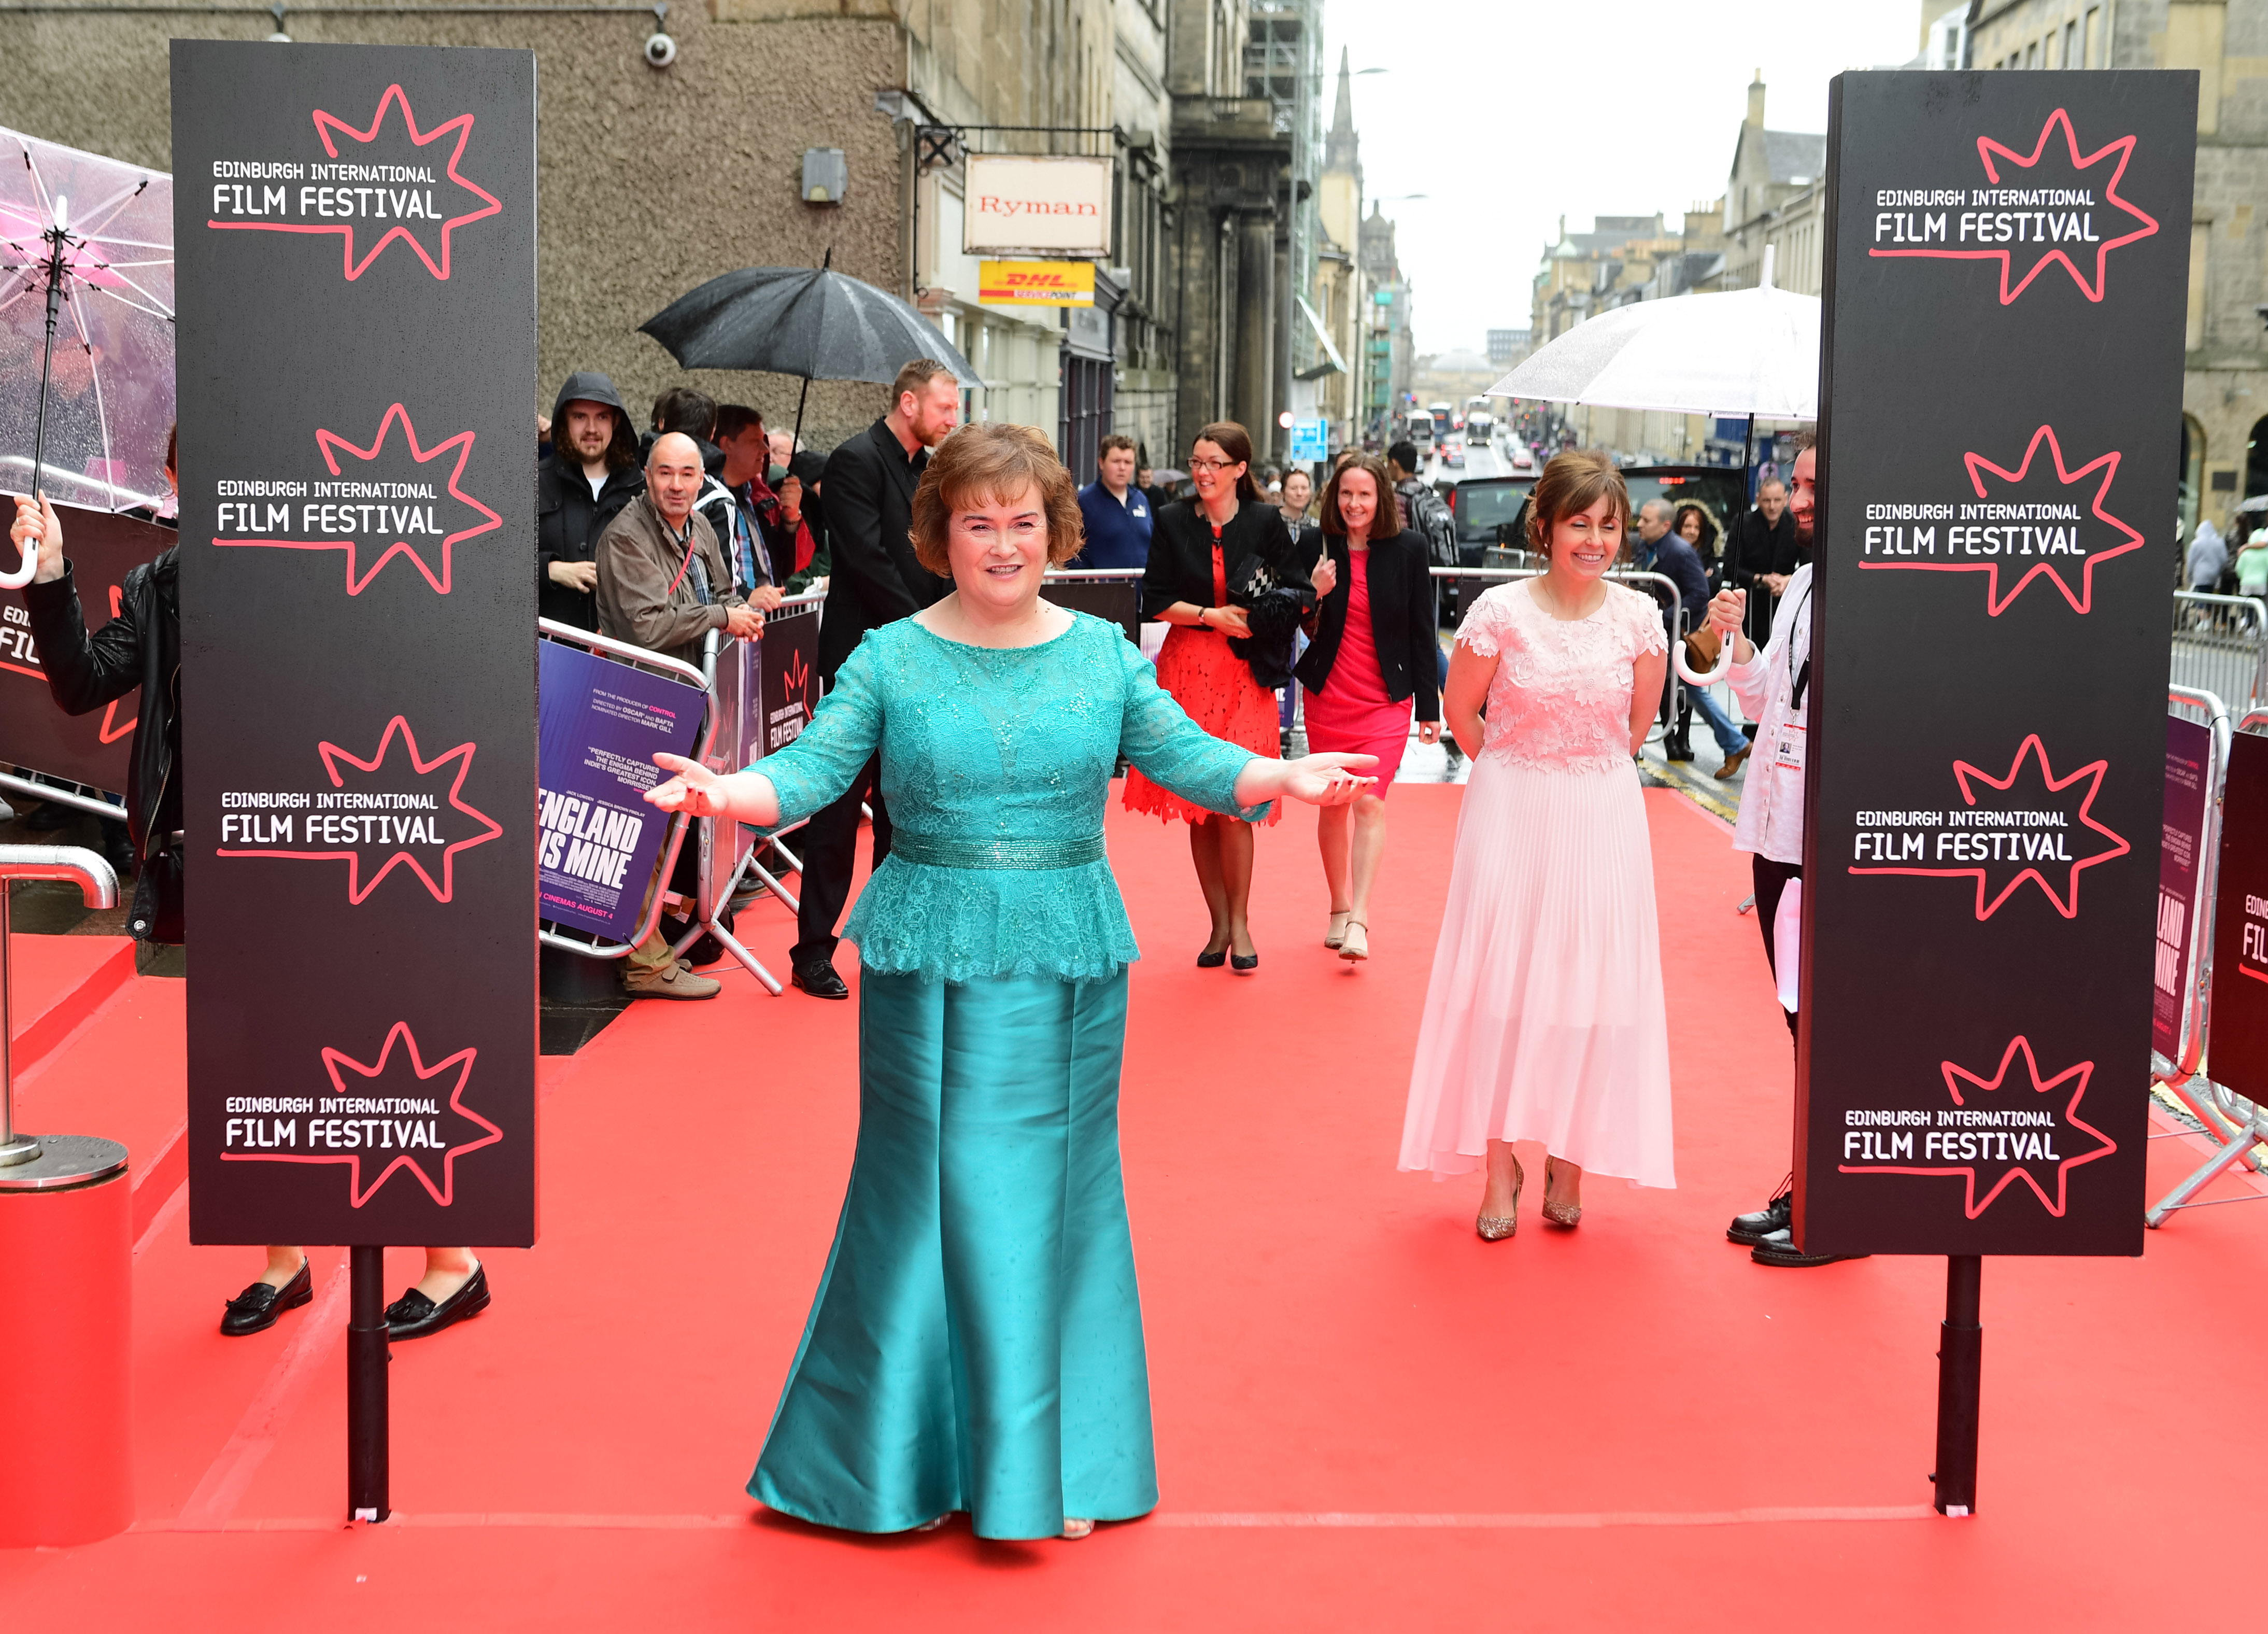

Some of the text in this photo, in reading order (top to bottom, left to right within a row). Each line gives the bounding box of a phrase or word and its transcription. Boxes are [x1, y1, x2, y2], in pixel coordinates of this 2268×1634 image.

[213, 161, 436, 183] EDINBURGH INTERNATIONAL
[214, 184, 443, 219] FILM FESTIVAL
[979, 196, 1097, 217] Ryman
[1877, 189, 2095, 206] EDINBURGH INTERNATIONAL
[1875, 212, 2100, 242] FILM FESTIVAL
[1007, 273, 1065, 286] DHL
[218, 480, 437, 499] EDINBURGH INTERNATIONAL
[218, 502, 444, 534] FILM FESTIVAL
[1866, 504, 2081, 520] EDINBURGH INTERNATIONAL
[1865, 526, 2086, 555] FILM FESTIVAL
[0, 626, 40, 664] FIL
[591, 705, 617, 716] NOMINATED
[618, 713, 641, 724] DIRECTOR
[641, 720, 658, 729] MARK
[593, 688, 606, 697] FROM
[617, 696, 641, 709] PRODUCER
[649, 706, 676, 719] CONTROL
[593, 699, 615, 709] DIRECTED
[655, 717, 674, 727] BAFTA
[770, 724, 783, 749] FILM
[584, 758, 657, 787] INDIE'S GREATEST ICON,
[596, 756, 658, 779] THE ENIGMA BEHIND
[626, 759, 659, 773] CAPTURES
[222, 792, 439, 810] EDINBURGH INTERNATIONAL
[222, 814, 445, 844] FILM FESTIVAL
[1856, 811, 2068, 827] EDINBURGH INTERNATIONAL
[538, 829, 566, 869] IS
[563, 838, 632, 890] MINE
[1854, 833, 2073, 861] FILM FESTIVAL
[543, 893, 576, 908] CINEMAS
[577, 904, 608, 918] AUGUST
[2157, 892, 2185, 949] LAND
[2243, 922, 2268, 964] FIL
[2154, 939, 2180, 996] MINE
[226, 1097, 440, 1114] EDINBURGH INTERNATIONAL
[1845, 1110, 2056, 1127] EDINBURGH INTERNATIONAL
[226, 1118, 446, 1148] FILM FESTIVAL
[1844, 1131, 2060, 1160] FILM FESTIVAL
